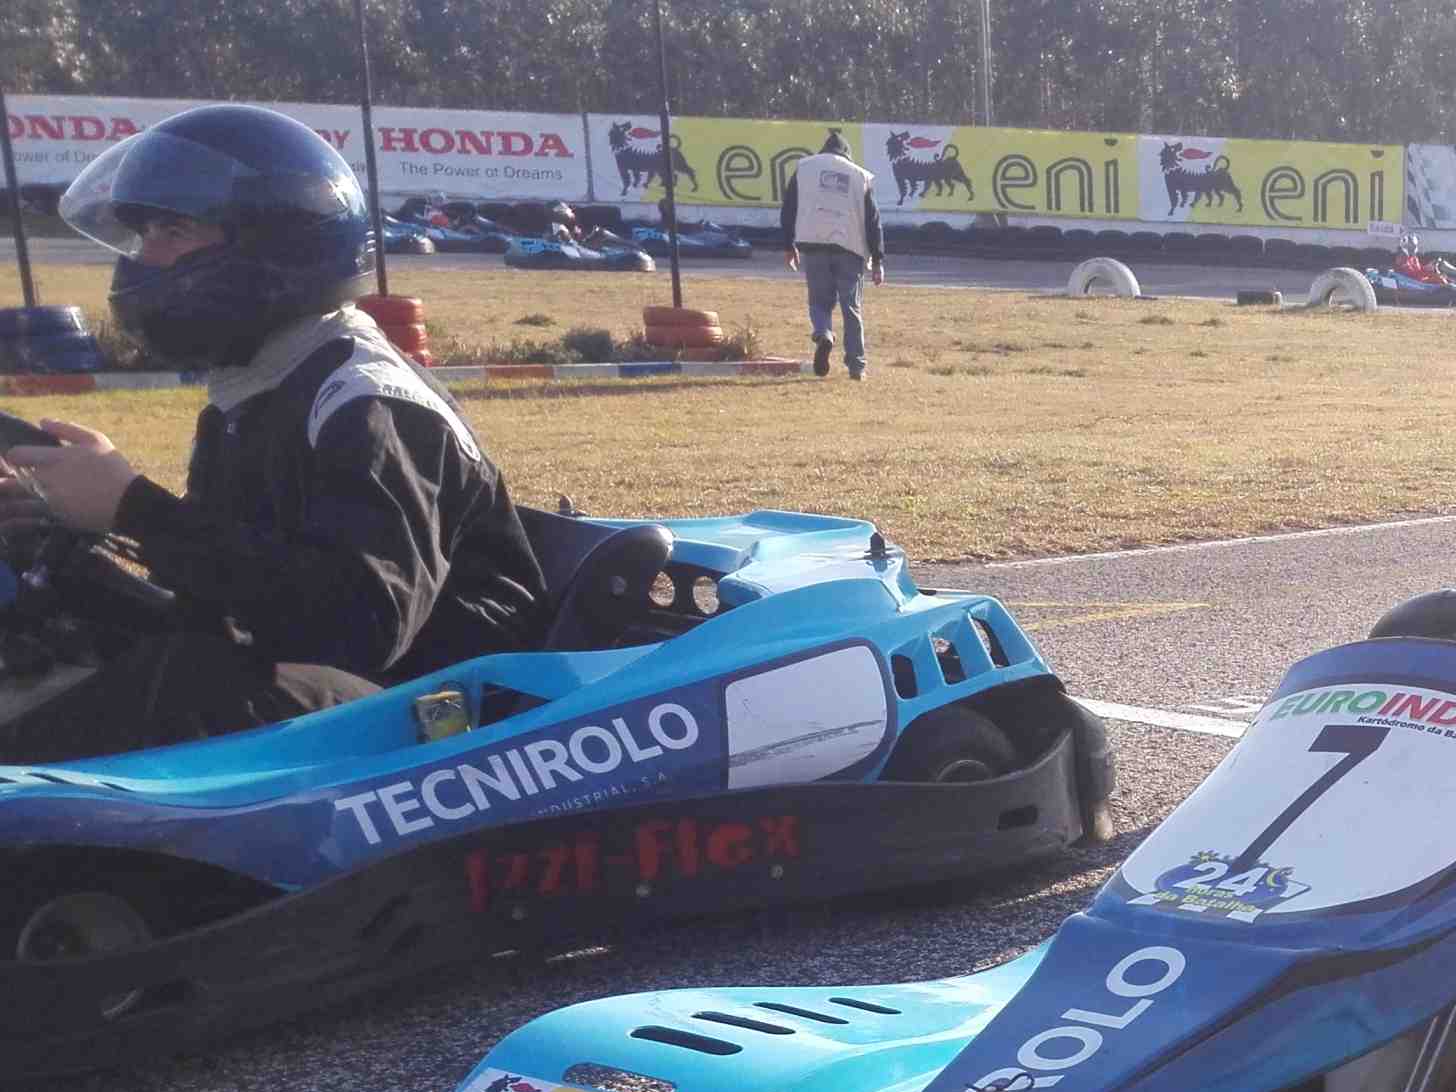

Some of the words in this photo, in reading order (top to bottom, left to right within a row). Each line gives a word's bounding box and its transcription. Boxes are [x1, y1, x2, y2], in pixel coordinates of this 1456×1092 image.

[378, 127, 574, 158] HONDA
[401, 161, 428, 175] The
[433, 163, 480, 177] Power
[503, 166, 562, 180] Dreams
[992, 138, 1120, 213] eni
[1261, 150, 1385, 224] eni
[1357, 716, 1425, 732] Kartódromo
[1427, 726, 1442, 737] da
[336, 704, 699, 845] TECNIROLO
[1230, 724, 1392, 873] 7
[1173, 861, 1269, 897] 24
